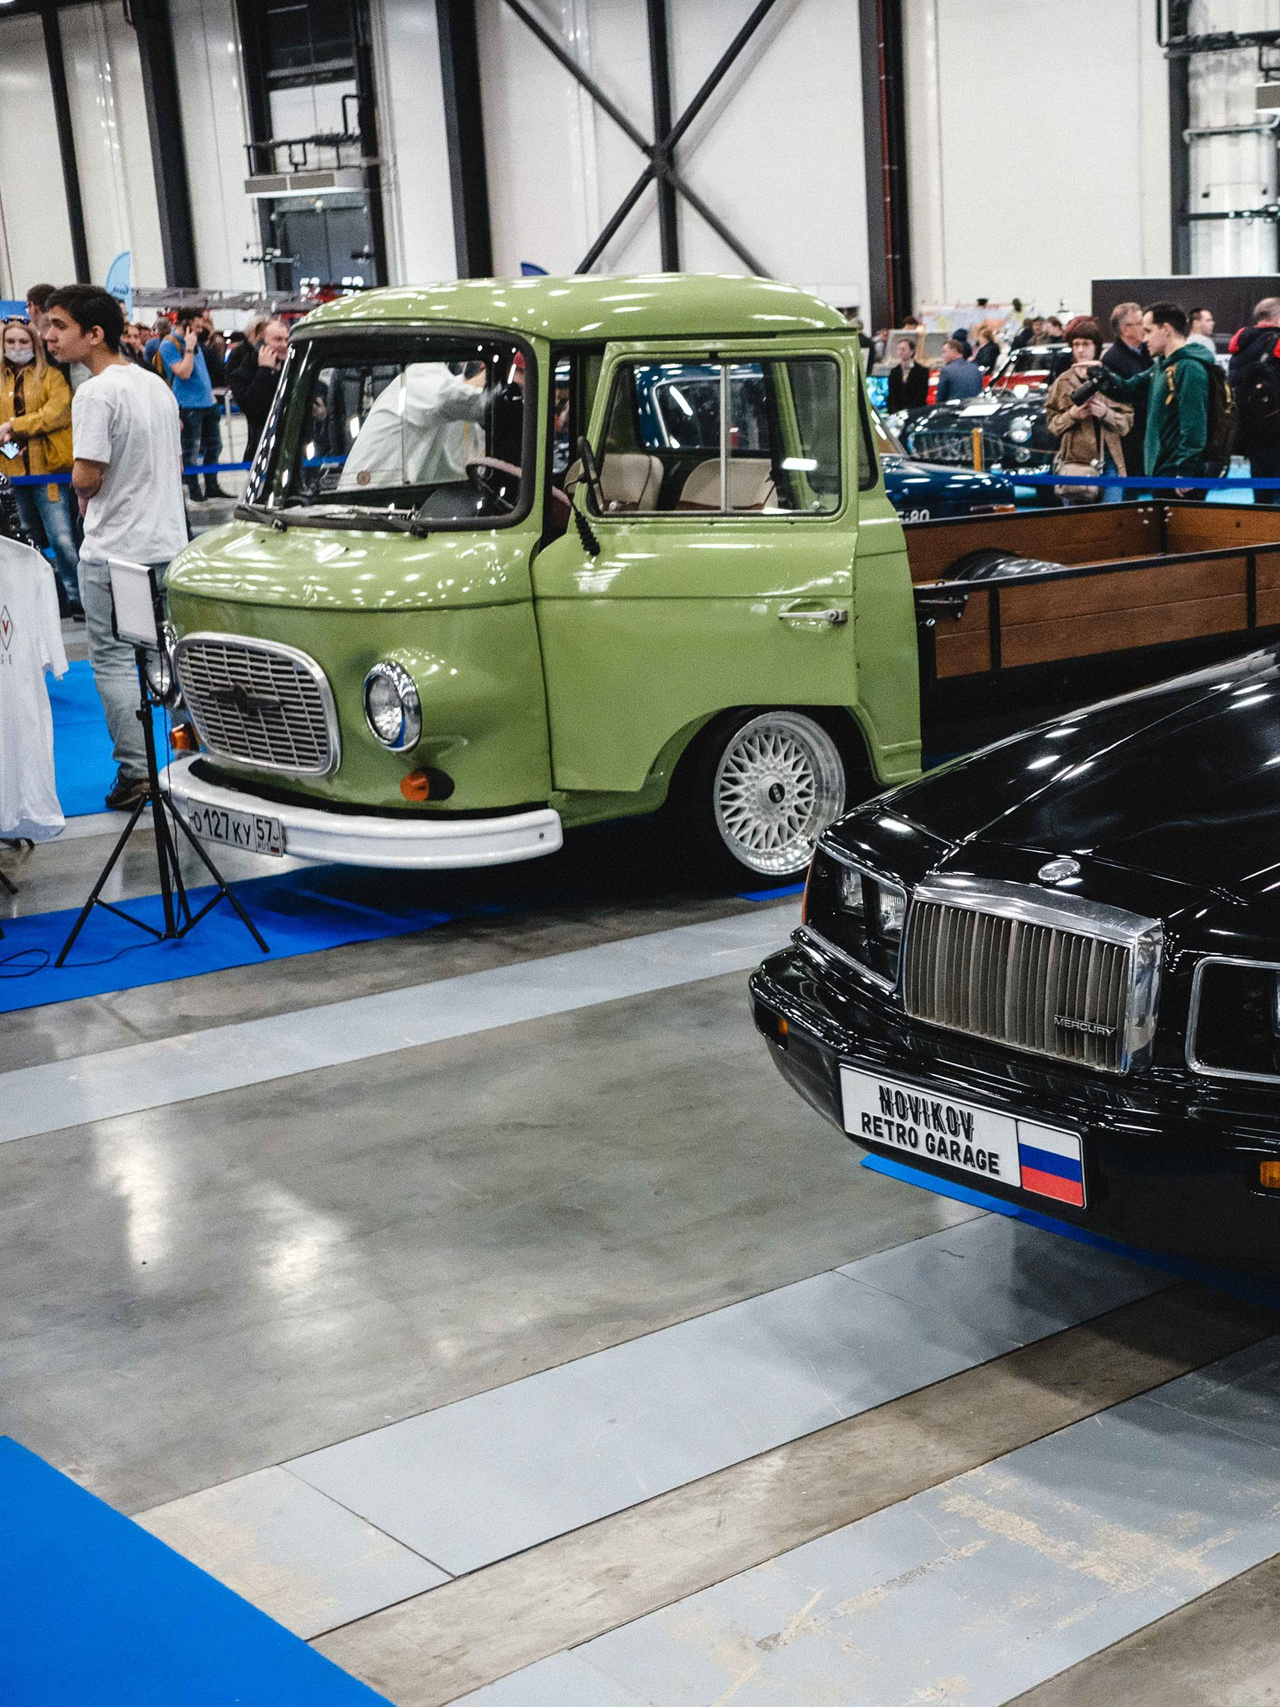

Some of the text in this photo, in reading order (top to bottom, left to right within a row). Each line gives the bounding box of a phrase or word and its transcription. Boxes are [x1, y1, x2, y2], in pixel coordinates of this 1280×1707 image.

[256, 819, 272, 842] 57
[1053, 1014, 1116, 1037] MERCURY
[878, 1085, 975, 1142] NOVIKOV
[861, 1112, 1000, 1176] RETRO GARAGE
